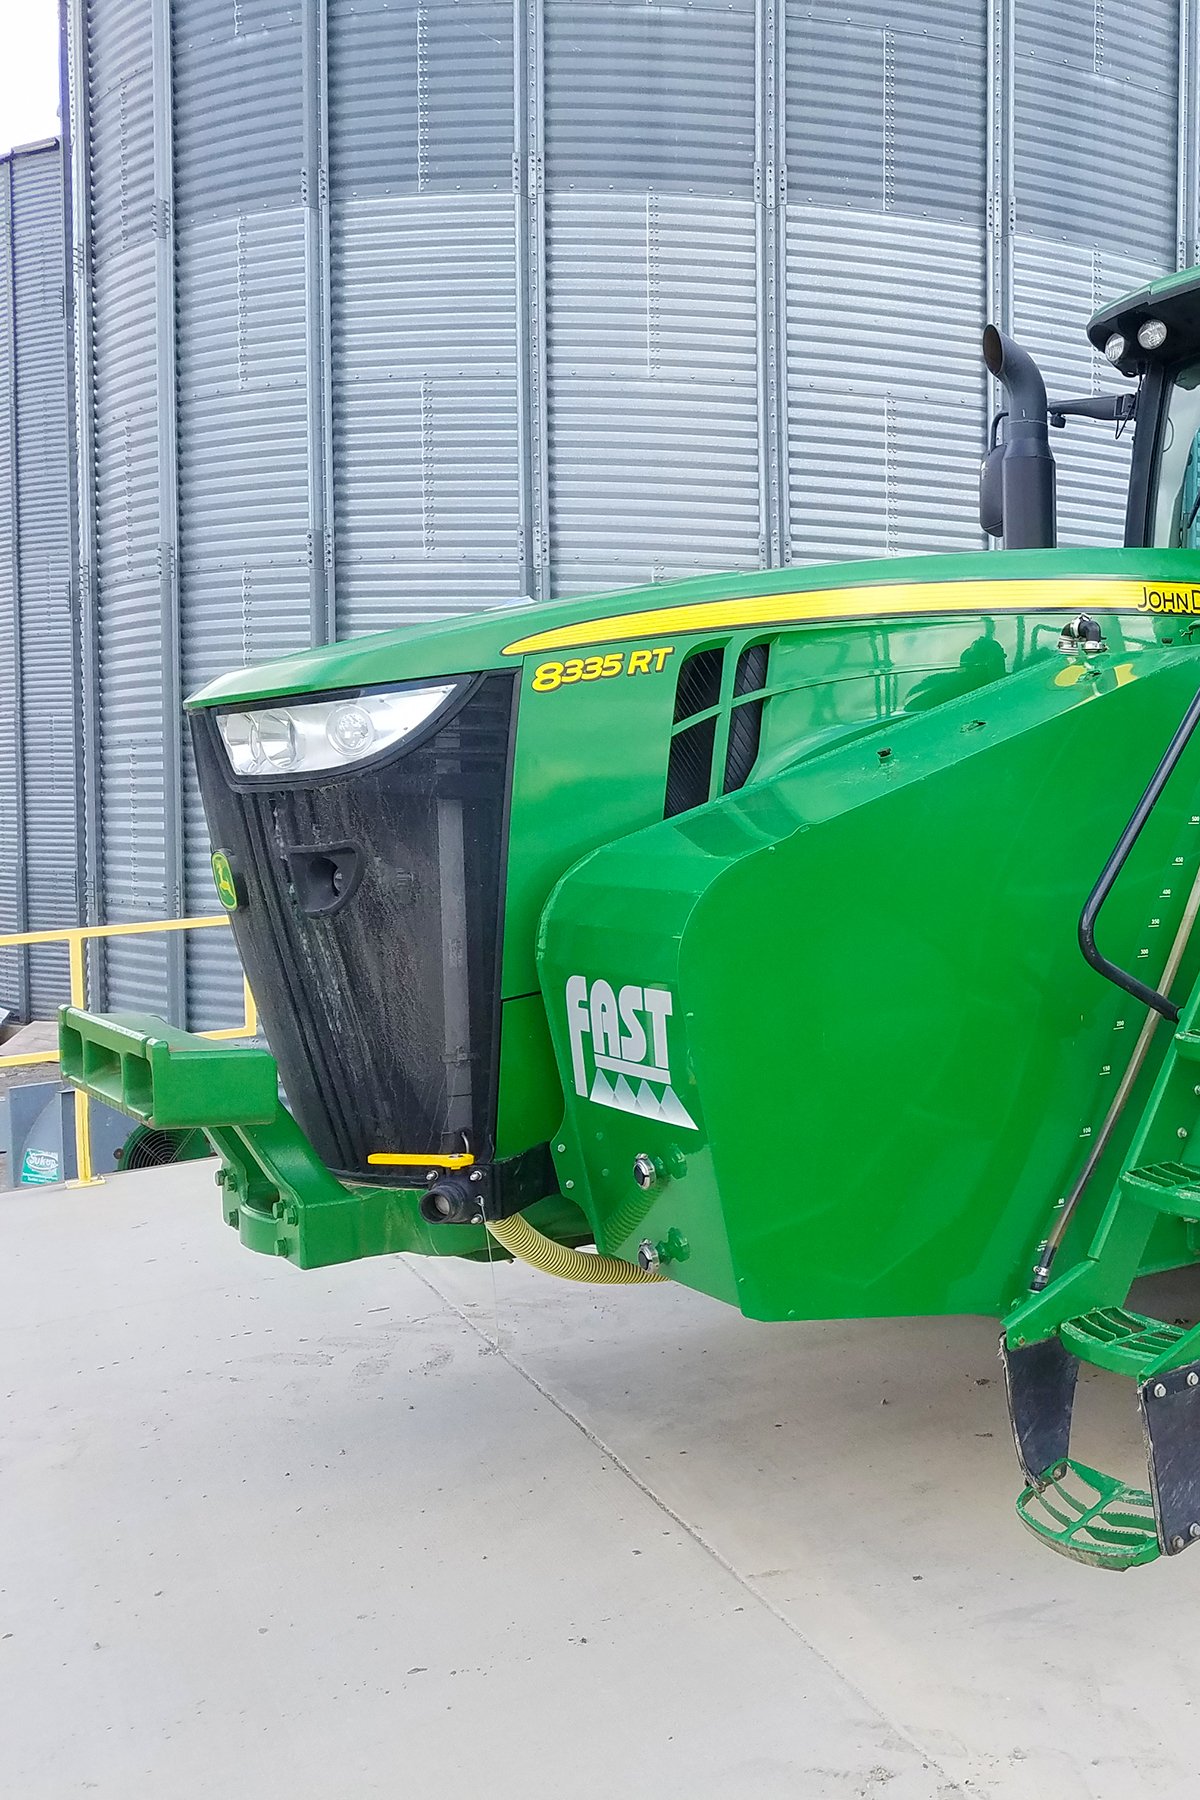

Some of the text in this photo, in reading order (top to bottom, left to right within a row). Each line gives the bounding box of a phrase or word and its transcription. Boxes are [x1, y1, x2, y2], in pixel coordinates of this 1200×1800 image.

[1138, 586, 1189, 610] JOHN
[532, 646, 675, 692] 8335 RT
[566, 975, 673, 1098] FAST
